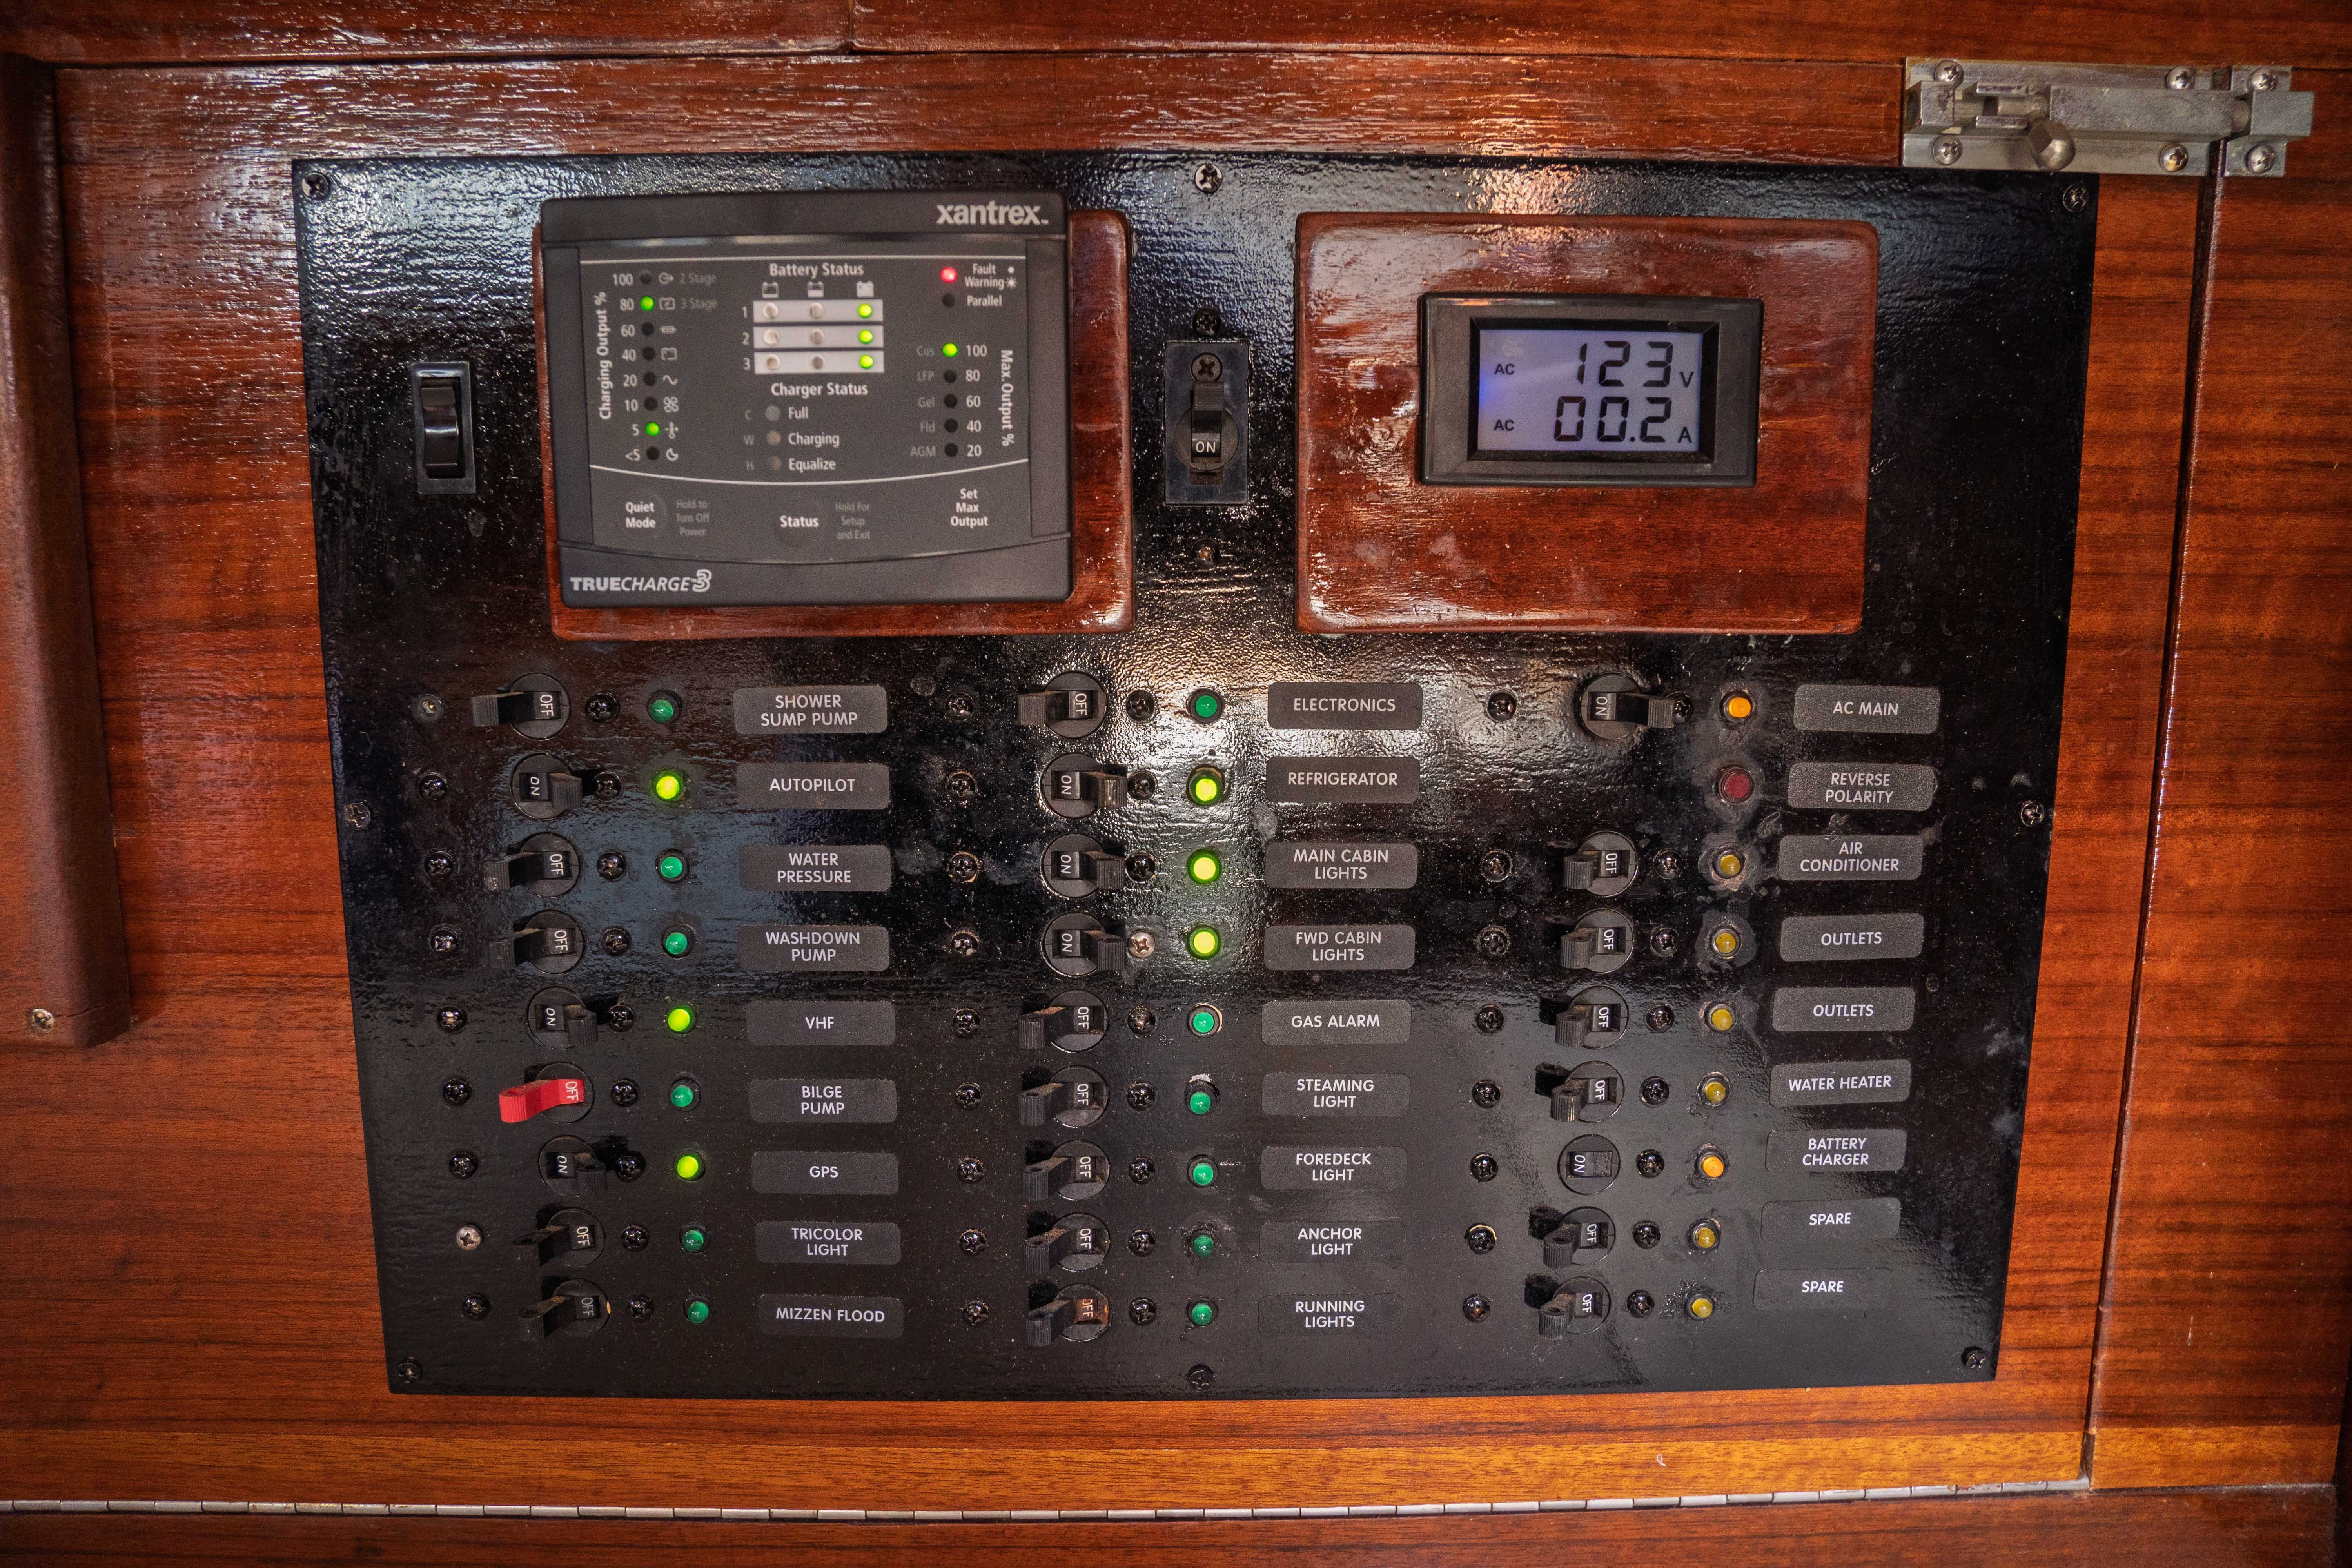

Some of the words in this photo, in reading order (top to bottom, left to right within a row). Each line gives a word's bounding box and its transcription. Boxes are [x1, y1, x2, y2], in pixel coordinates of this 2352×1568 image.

[769, 263, 818, 278] Battery
[822, 263, 864, 276] Status
[972, 263, 996, 274] Fault
[613, 274, 633, 286] 100
[689, 272, 717, 286] Stage
[964, 276, 1005, 290] Warning
[593, 292, 607, 306] %
[620, 298, 634, 311] 80
[689, 298, 718, 311] Stage
[967, 296, 1003, 307] Parallel
[742, 307, 748, 318] 1
[595, 309, 611, 356] Output
[621, 324, 635, 337] 60
[742, 333, 750, 345] 2
[622, 349, 637, 361] 40
[916, 346, 935, 357] Cus
[965, 345, 987, 357] 100
[743, 358, 751, 370] 3
[1494, 364, 1515, 375] AC
[1577, 341, 1673, 388] 123
[1680, 371, 1695, 388] V
[623, 374, 637, 387] 20
[917, 370, 935, 382] LFP
[965, 370, 981, 382] 80
[597, 359, 613, 420] Charging
[771, 383, 823, 399] Charger
[827, 382, 869, 395] Status
[625, 399, 639, 411] 10
[918, 396, 935, 408] Gel
[966, 396, 981, 408] 60
[788, 407, 809, 419] Full
[1494, 420, 1514, 432] AC
[1554, 396, 1672, 443] 00.2
[1678, 427, 1692, 443] A
[632, 424, 639, 436] 5
[966, 419, 982, 432] 40
[744, 435, 755, 445] W
[788, 433, 840, 448] Charging
[1002, 433, 1015, 447] %
[909, 446, 936, 457] AGM
[967, 445, 982, 457] 20
[1195, 441, 1216, 453] ON
[789, 458, 836, 473] Equalize
[960, 488, 978, 499] Set
[626, 501, 655, 513] Quiet
[676, 499, 693, 509] Hold
[695, 499, 707, 509] to
[835, 501, 854, 512] Hold
[856, 501, 870, 512] For
[956, 502, 980, 513] Max
[626, 517, 656, 528] Mode
[675, 513, 694, 522] Turn
[696, 512, 709, 522] Off
[780, 515, 820, 528] Status
[840, 516, 865, 527] Setup
[950, 515, 989, 528] Output
[679, 527, 706, 537] Power
[836, 530, 853, 540] and
[855, 530, 871, 540] Exit
[540, 694, 554, 717] OFF
[775, 695, 842, 708] SHOWER
[1075, 693, 1087, 715] OFF
[1294, 698, 1396, 711] ELECTRONICS
[1595, 696, 1608, 716] ON
[1833, 701, 1854, 715] AC
[1859, 702, 1898, 715] MAIN
[761, 713, 806, 727] SUMP
[812, 712, 858, 726] PUMP
[769, 778, 855, 791] AUTOPILOT
[1061, 775, 1072, 795] ON
[1288, 772, 1398, 786] REFRIGERATOR
[1831, 773, 1891, 786] REVERSE
[529, 777, 540, 796] ON
[1826, 790, 1893, 803] POLARITY
[1839, 842, 1862, 855] AIR
[789, 853, 838, 866] WATER
[1294, 849, 1335, 862] MAIN
[1341, 849, 1388, 862] CABIN
[550, 854, 564, 876] OFF
[1061, 855, 1071, 874] ON
[1606, 853, 1617, 874] OFF
[1800, 859, 1899, 872] CONDITIONER
[777, 870, 851, 883] PRESSURE
[1315, 867, 1367, 880] LIGHTS
[554, 930, 568, 951] OFF
[766, 932, 860, 944] WASHDOWN
[1062, 933, 1072, 952] ON
[1296, 932, 1328, 944] FWD
[1334, 931, 1381, 944] CABIN
[1604, 929, 1614, 950] OFF
[1821, 932, 1882, 946] OUTLETS
[791, 949, 836, 961] PUMP
[1312, 948, 1365, 961] LIGHTS
[546, 1008, 556, 1026] ON
[1813, 1004, 1874, 1017] OUTLETS
[805, 1016, 834, 1029] VHF
[1078, 1007, 1089, 1029] OFF
[1291, 1015, 1322, 1028] GAS
[1328, 1014, 1380, 1027] ALARM
[1598, 1007, 1609, 1028] OFF
[1297, 1079, 1374, 1092] STEAMING
[1789, 1077, 1835, 1091] WATER
[1840, 1075, 1891, 1089] HEATER
[565, 1081, 579, 1101] OFF
[802, 1086, 842, 1098] BILGE
[1077, 1084, 1089, 1106] OFF
[1595, 1080, 1605, 1100] OFF
[801, 1102, 845, 1114] PUMP
[1314, 1096, 1356, 1108] LIGHT
[1808, 1138, 1866, 1150] BATTERY
[557, 1156, 568, 1173] ON
[1296, 1153, 1372, 1165] FOREDECK
[1574, 1155, 1586, 1173] ON
[1802, 1153, 1869, 1165] CHARGER
[809, 1166, 838, 1178] GPS
[1080, 1156, 1091, 1178] OFF
[1312, 1169, 1354, 1181] LIGHT
[1809, 1212, 1851, 1225] SPARE
[577, 1226, 590, 1245] OFF
[791, 1227, 862, 1240] TRICOLOR
[1080, 1228, 1091, 1249] OFF
[1298, 1228, 1362, 1240] ANCHOR
[1587, 1224, 1597, 1243] OFF
[807, 1244, 848, 1256] LIGHT
[1311, 1243, 1353, 1255] LIGHT
[1802, 1281, 1843, 1293] SPARE
[581, 1298, 594, 1316] OFF
[1296, 1300, 1365, 1312] RUNNING
[1582, 1294, 1592, 1313] OFF
[776, 1307, 831, 1320] MIZZEN
[837, 1310, 885, 1322] FLOOD
[1305, 1316, 1355, 1328] LIGHTS
